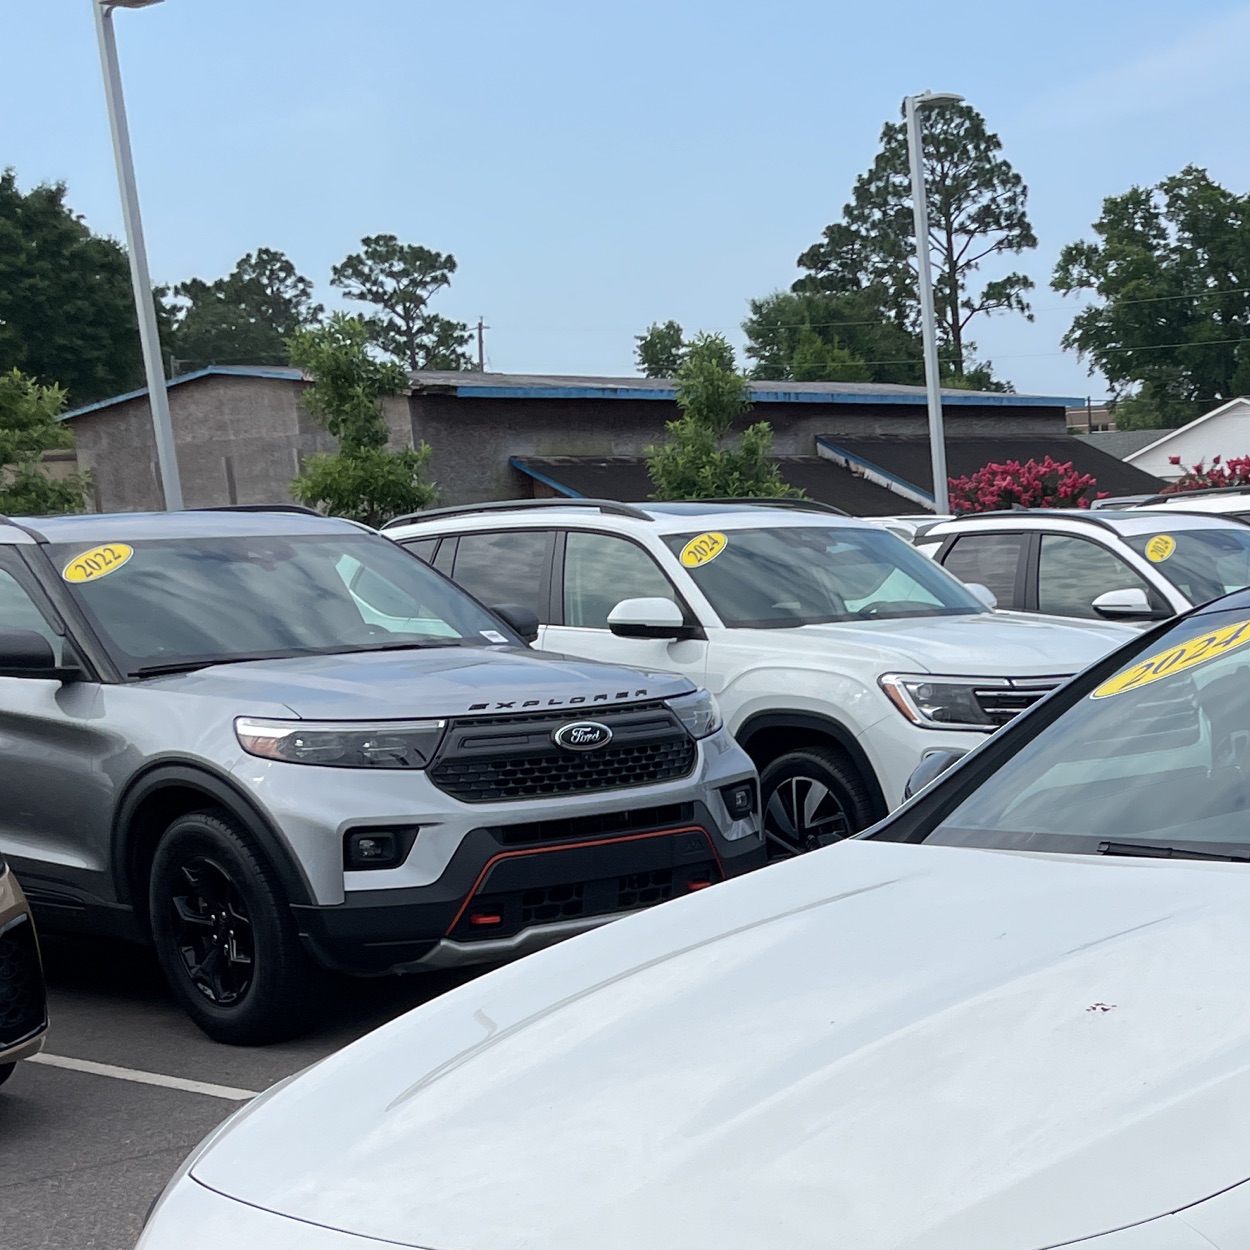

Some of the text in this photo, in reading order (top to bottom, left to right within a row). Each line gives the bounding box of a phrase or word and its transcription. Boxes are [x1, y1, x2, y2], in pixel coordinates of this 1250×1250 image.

[75, 547, 122, 578] 2022
[688, 534, 720, 563] 2024
[1118, 621, 1250, 691] 2024
[468, 689, 648, 711] EXPLORER
[570, 727, 600, 743] Ford
